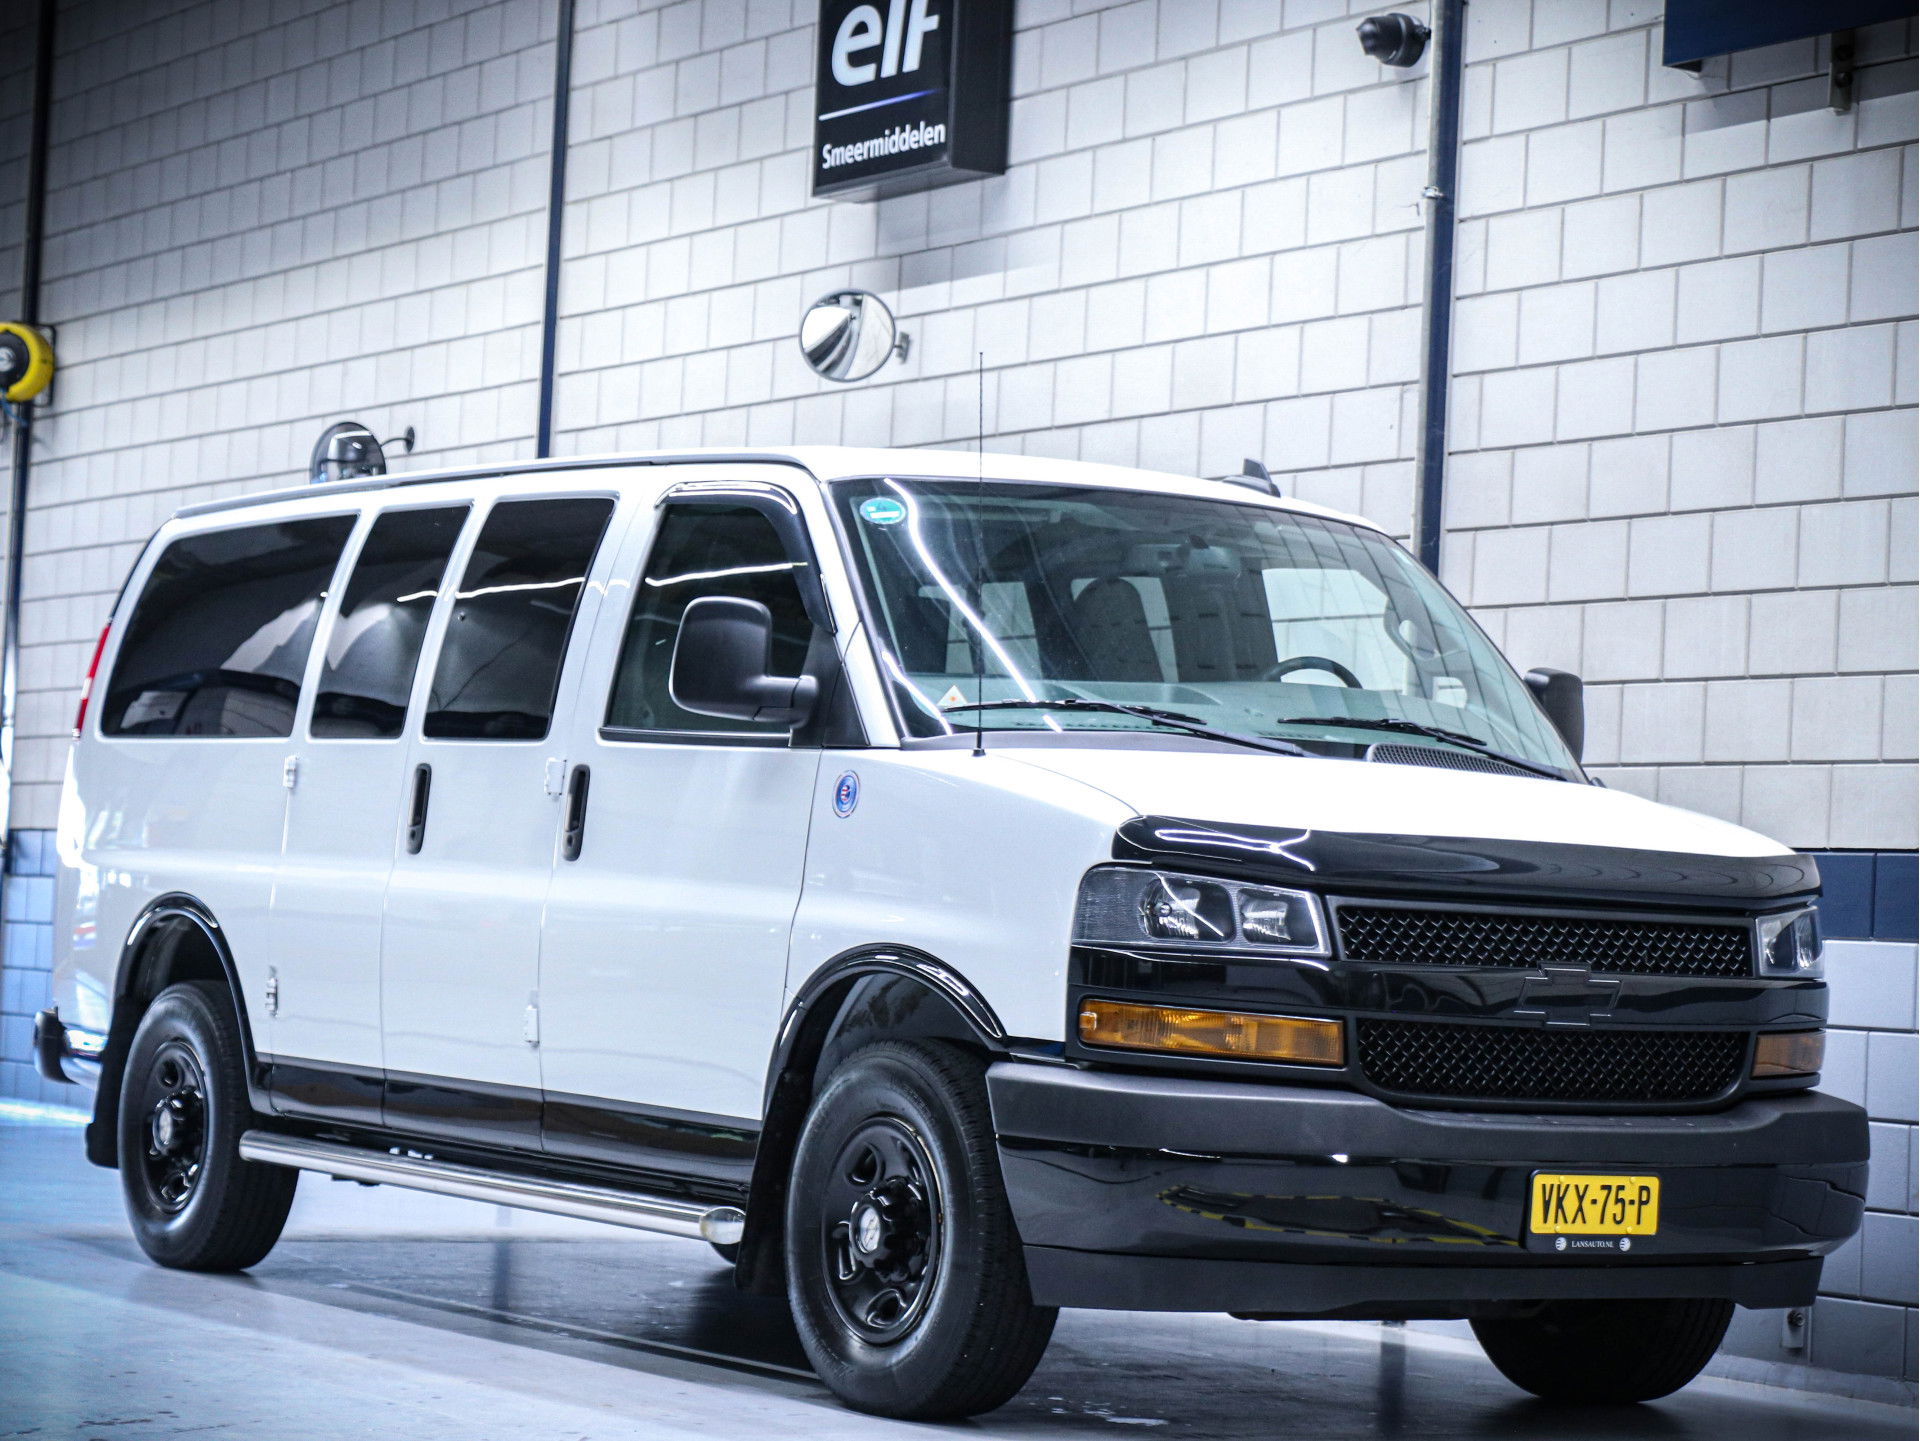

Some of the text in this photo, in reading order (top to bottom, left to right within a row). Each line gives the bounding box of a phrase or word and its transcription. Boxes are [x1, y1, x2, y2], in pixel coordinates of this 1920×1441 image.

[831, 0, 940, 87] elf
[822, 120, 946, 169] Smeermiddelen
[1541, 1183, 1651, 1225] VKX-75-P
[1571, 1240, 1614, 1248] LANSAUTO.NL
